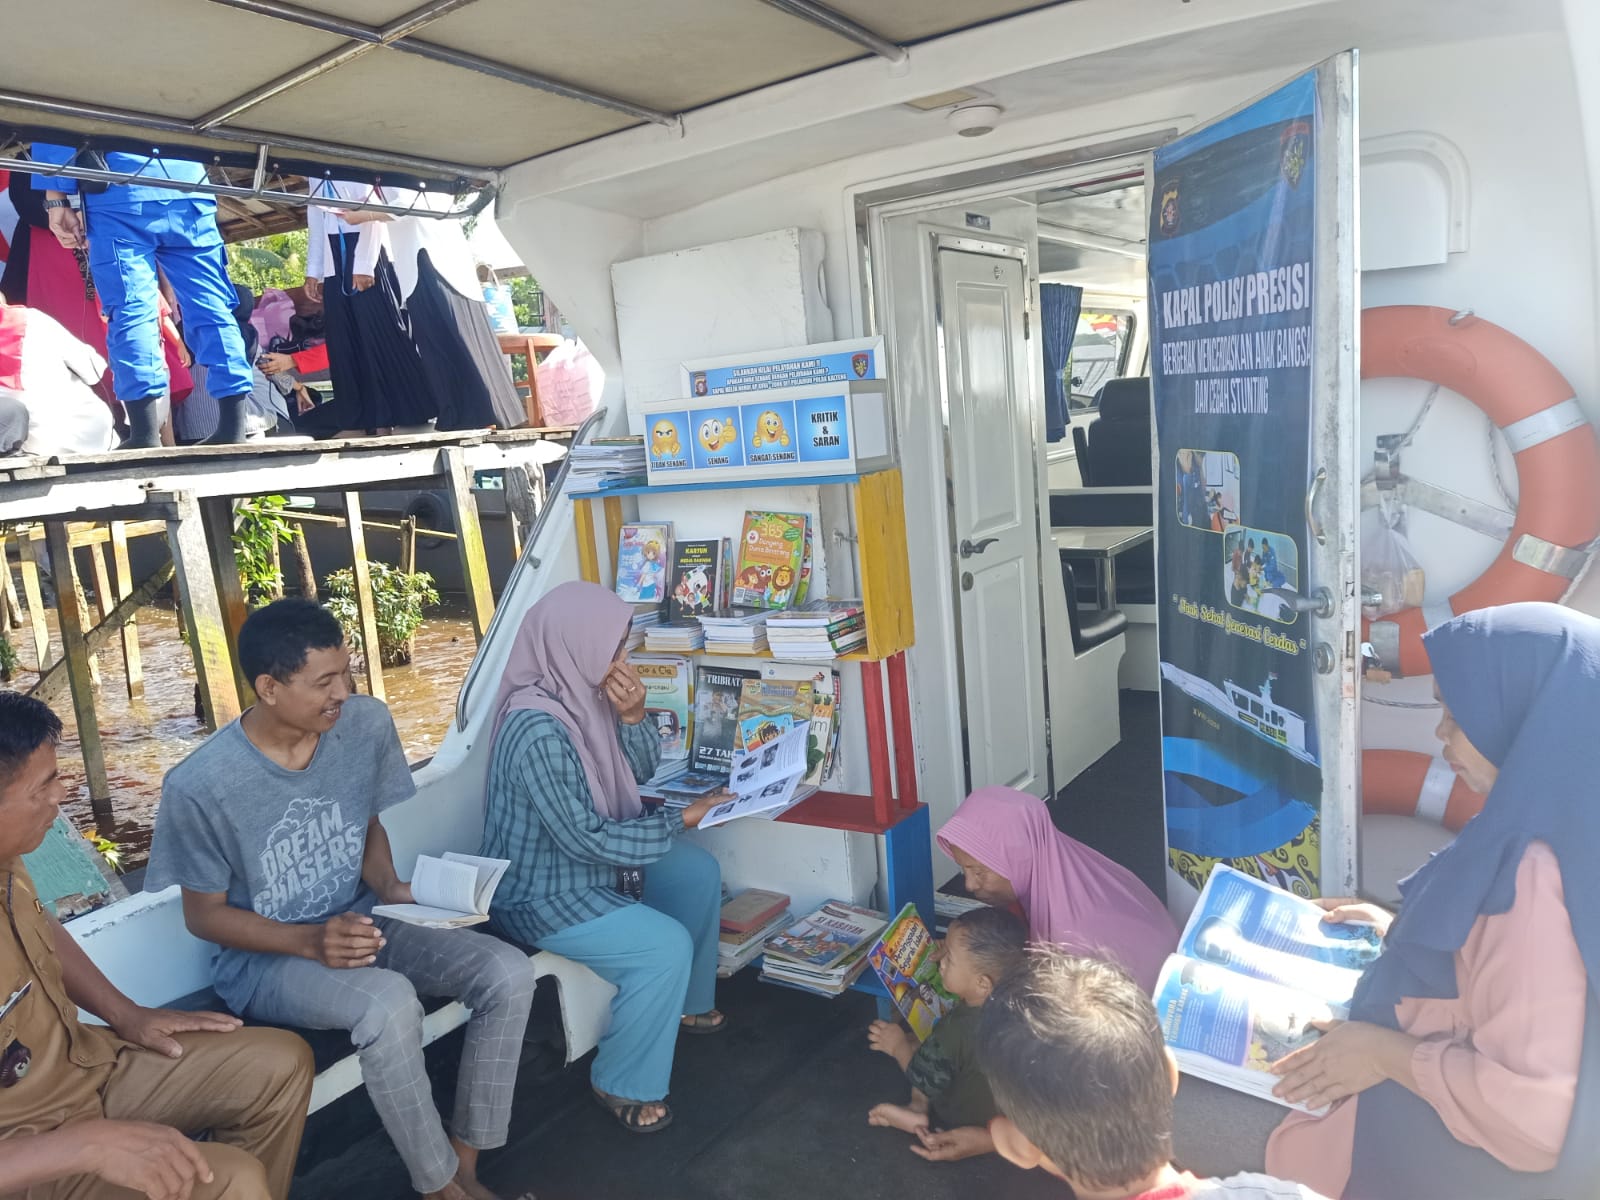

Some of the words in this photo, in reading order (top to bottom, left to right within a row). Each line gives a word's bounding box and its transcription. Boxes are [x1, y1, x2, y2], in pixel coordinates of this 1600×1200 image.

[1162, 286, 1202, 328] KAPAL
[1204, 276, 1244, 323] POLISI
[1246, 262, 1310, 316] PRESISI
[1162, 340, 1196, 375] BERGERAK
[1255, 330, 1275, 369] ANAK
[1277, 326, 1311, 368] BANGSA
[1195, 379, 1208, 413] DAN
[1209, 378, 1229, 414] CEGAH
[1230, 376, 1269, 414] STUNTING
[811, 411, 838, 423] KRITIK
[822, 426, 829, 434] &
[813, 435, 840, 447] SARAN
[666, 459, 687, 467] SENANG
[707, 456, 729, 465] SENANG
[750, 453, 770, 462] SANGAT
[771, 452, 796, 461] SENANG
[760, 522, 784, 538] 365
[1200, 605, 1225, 628] Sehat
[1263, 626, 1299, 655] Cerdas
[707, 675, 740, 687] TRIBRAT
[699, 746, 713, 755] 27
[715, 748, 733, 758] TAH
[259, 802, 343, 886] DREAM
[253, 824, 362, 919] CHASERS
